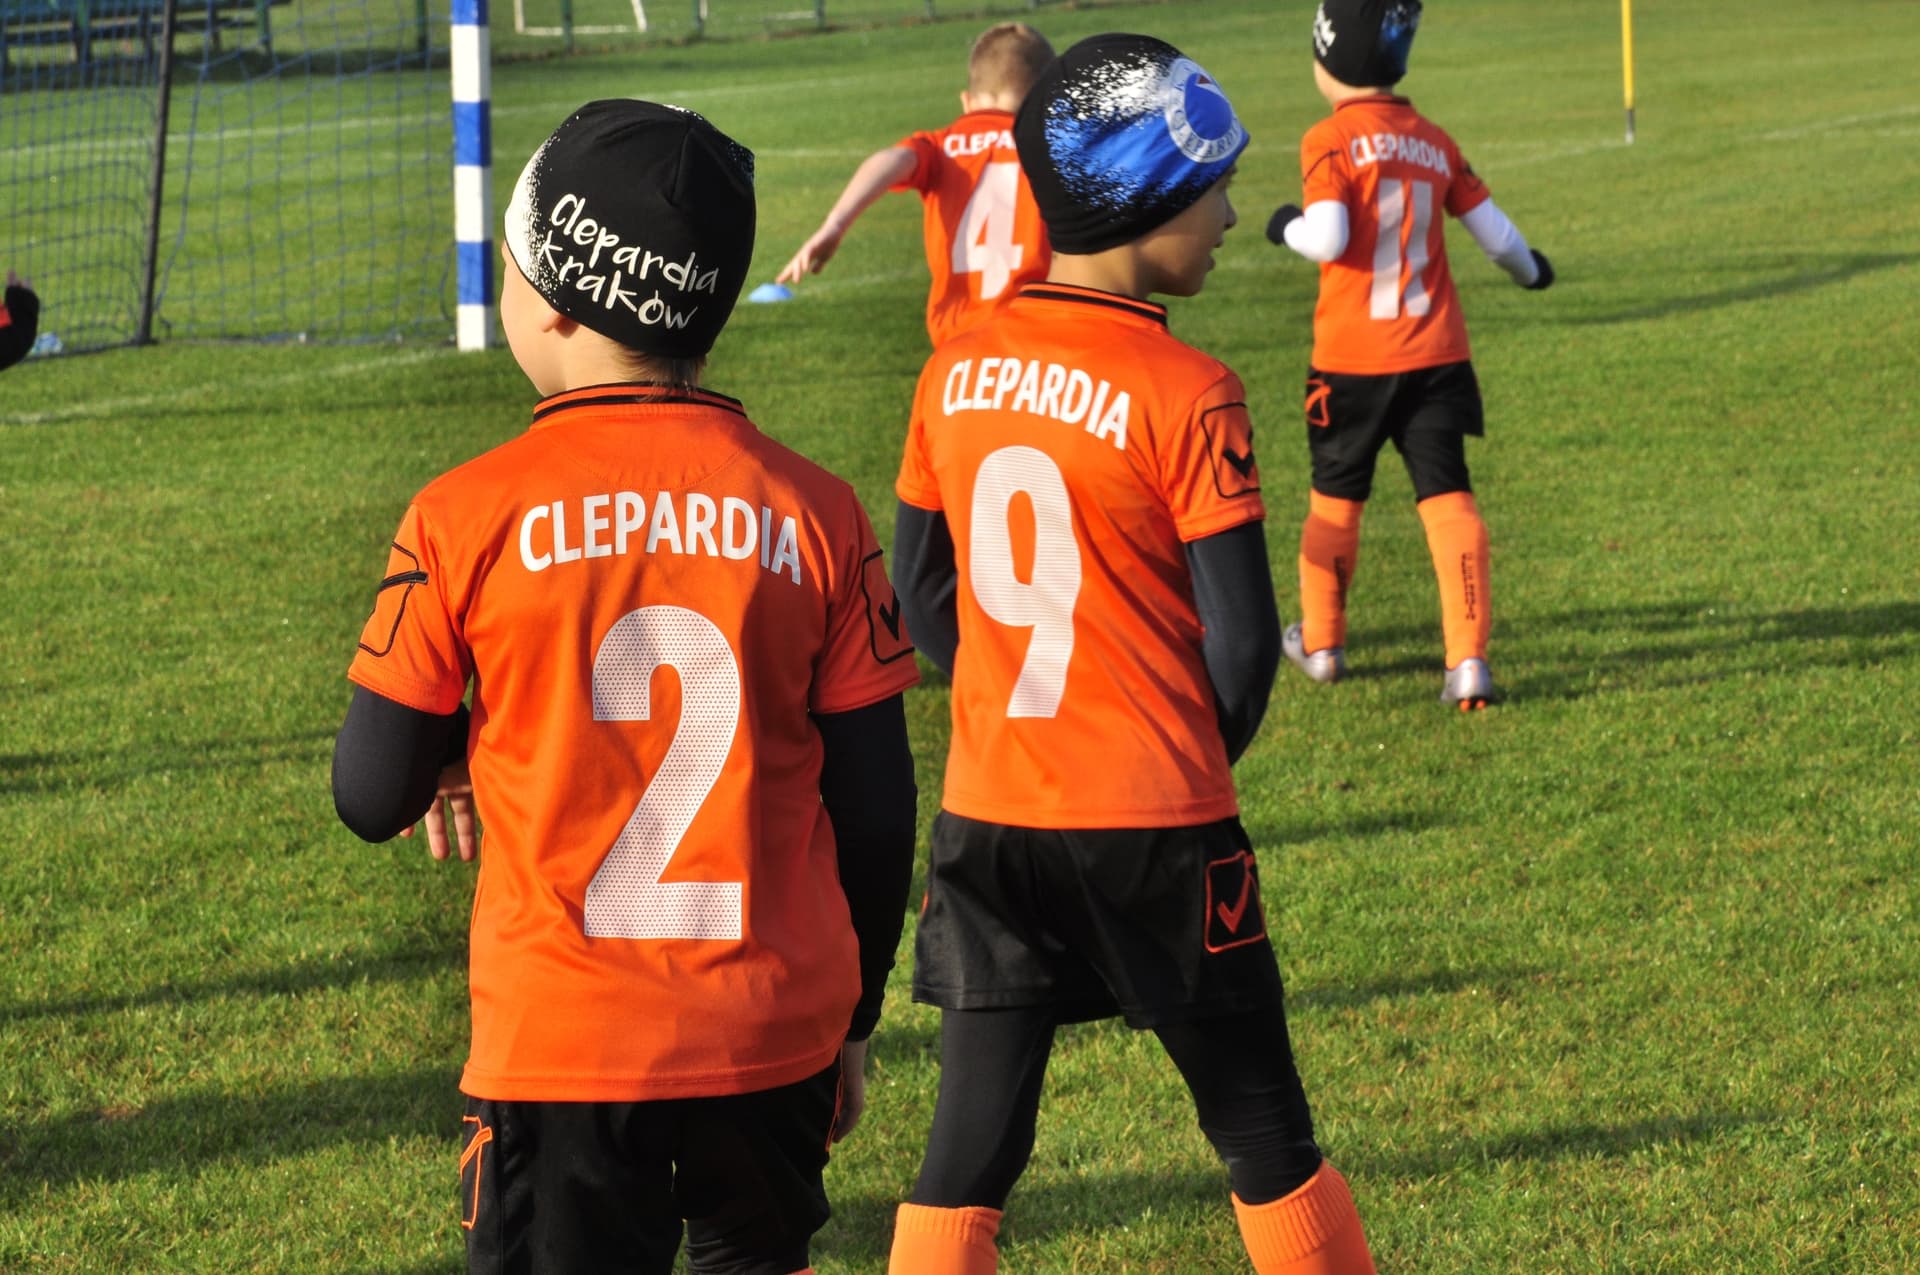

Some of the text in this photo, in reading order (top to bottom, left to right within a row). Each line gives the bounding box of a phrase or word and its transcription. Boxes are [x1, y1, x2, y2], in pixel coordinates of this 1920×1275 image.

[943, 130, 1017, 159] CLEPA
[1350, 133, 1450, 178] CLEPARDIA
[550, 194, 719, 294] Clepardia
[952, 162, 1024, 300] 4
[1370, 178, 1433, 319] 11
[943, 357, 1130, 450] CLEPARDIA
[520, 490, 801, 586] CLEPARDIA
[969, 445, 1082, 718] 9
[584, 605, 742, 939] 2
